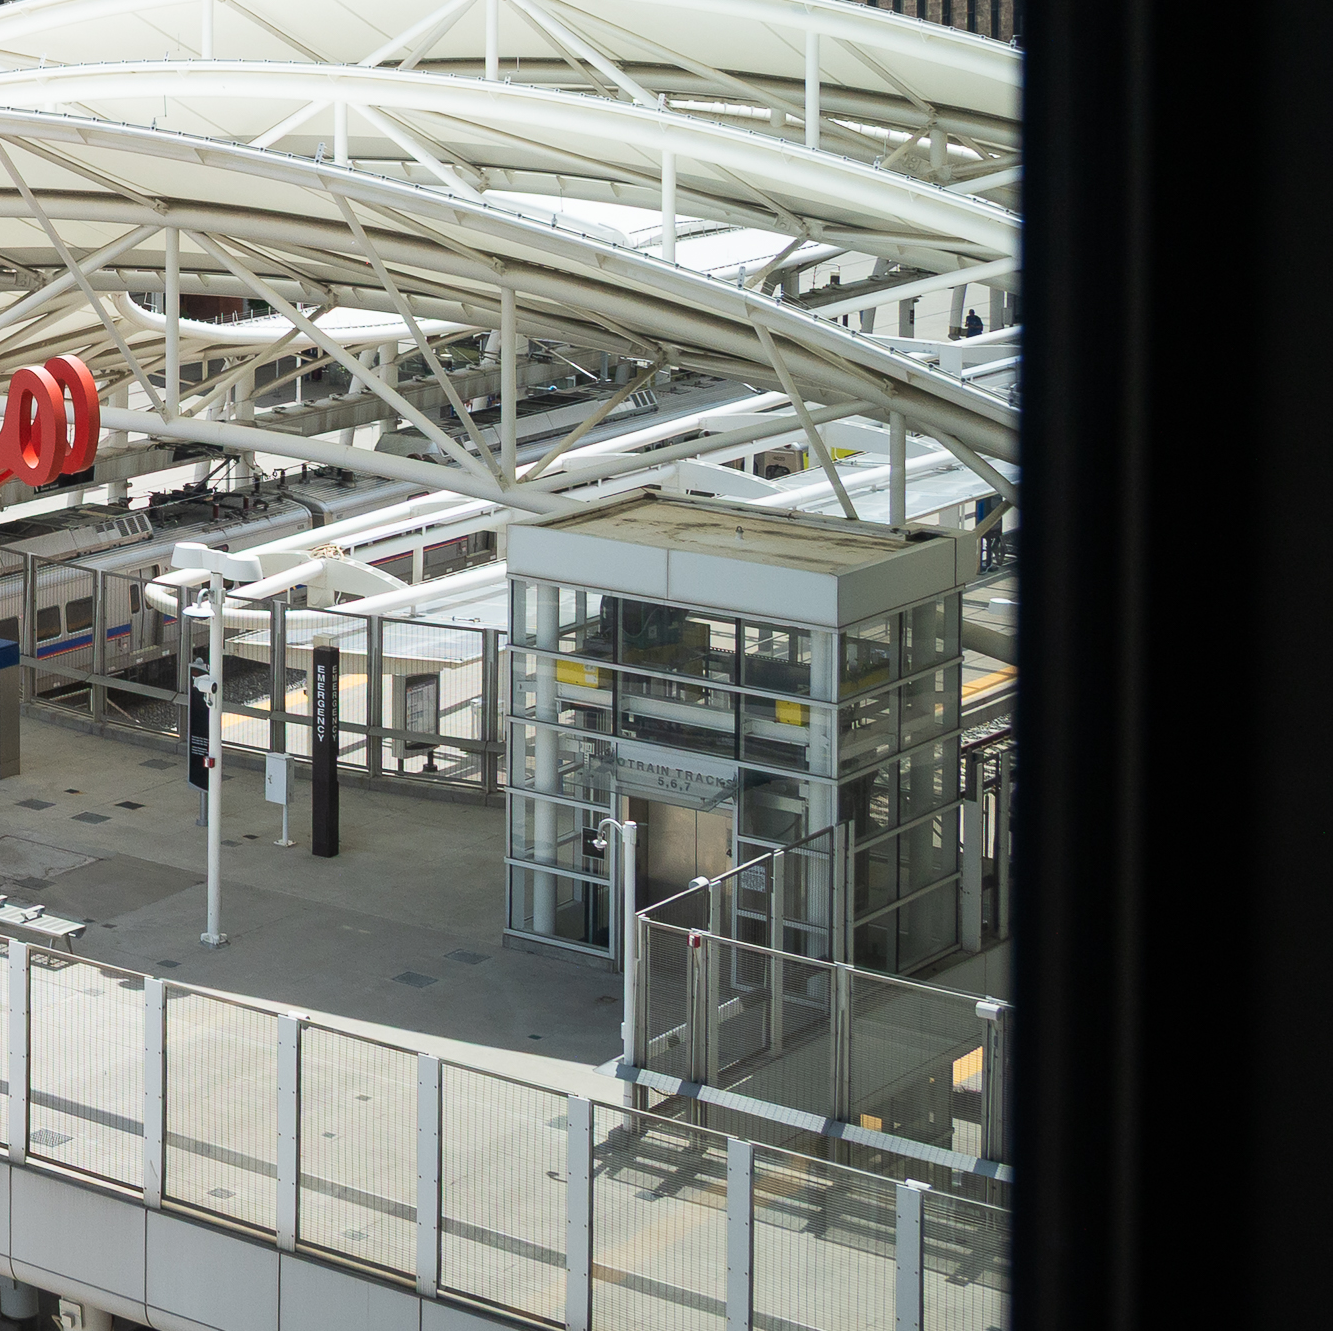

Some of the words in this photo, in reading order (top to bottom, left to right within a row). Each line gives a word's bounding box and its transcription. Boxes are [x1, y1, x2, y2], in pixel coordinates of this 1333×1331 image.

[317, 664, 326, 742] EMERGENCY
[627, 758, 670, 776] TRAIN
[675, 767, 733, 789] TRACKS
[657, 776, 691, 792] 5,6,7
